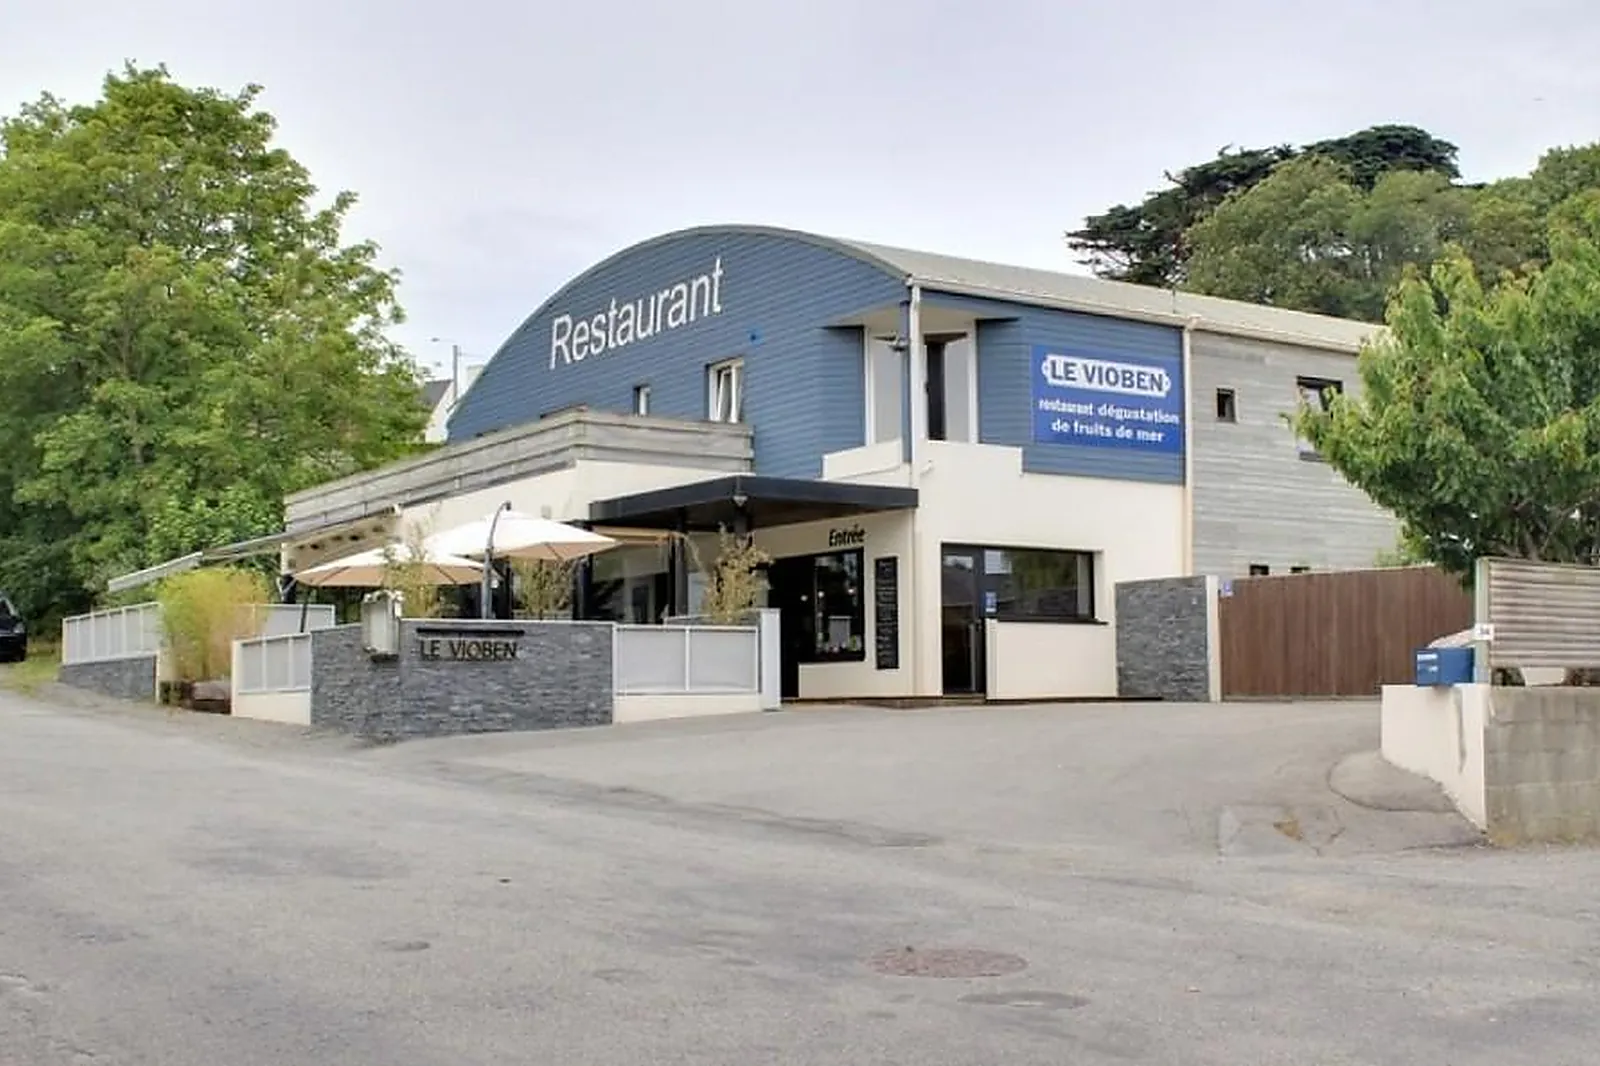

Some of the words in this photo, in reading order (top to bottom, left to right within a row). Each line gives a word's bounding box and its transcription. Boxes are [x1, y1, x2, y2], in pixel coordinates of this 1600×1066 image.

[549, 256, 724, 370] Restaurant
[1050, 359, 1077, 382] LE
[1083, 364, 1163, 392] VIOBEN
[1097, 403, 1179, 424] dégustation
[1051, 419, 1070, 433] de
[1073, 420, 1112, 437] fruits
[1115, 425, 1133, 439] de
[1136, 429, 1165, 442] mer
[829, 524, 866, 547] Entrée
[420, 640, 441, 657] LE
[448, 640, 517, 659] VIOBEN
